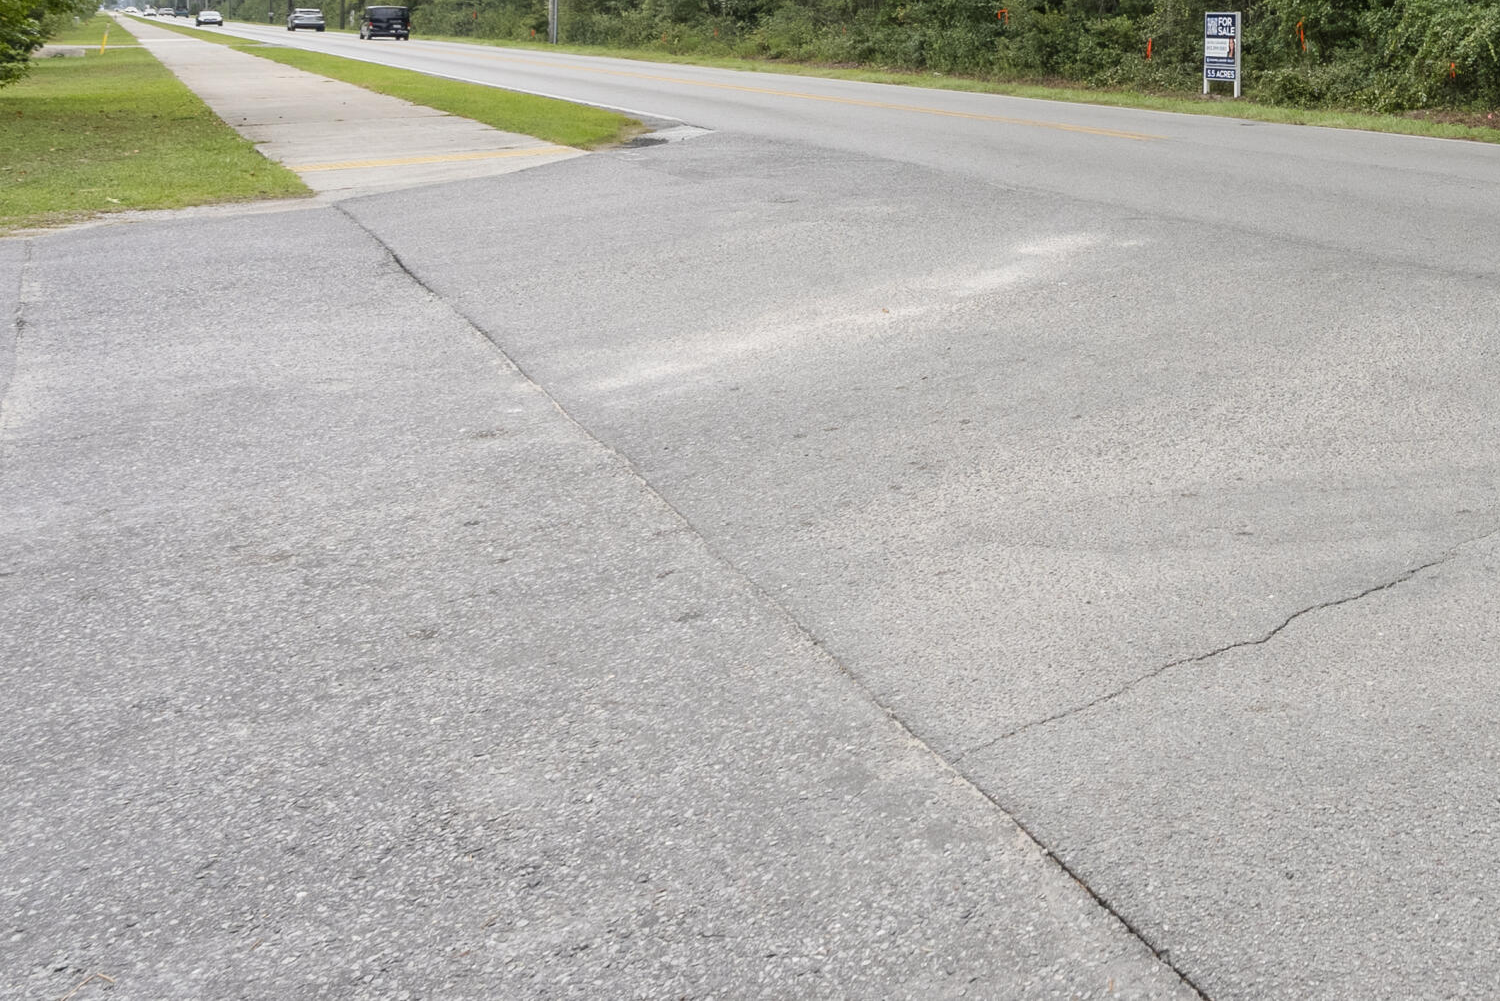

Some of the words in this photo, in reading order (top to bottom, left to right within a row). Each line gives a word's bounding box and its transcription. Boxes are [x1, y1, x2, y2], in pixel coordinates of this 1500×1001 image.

[1218, 17, 1232, 26] FOR
[1218, 26, 1235, 36] SALE
[1216, 70, 1235, 78] ACRES
